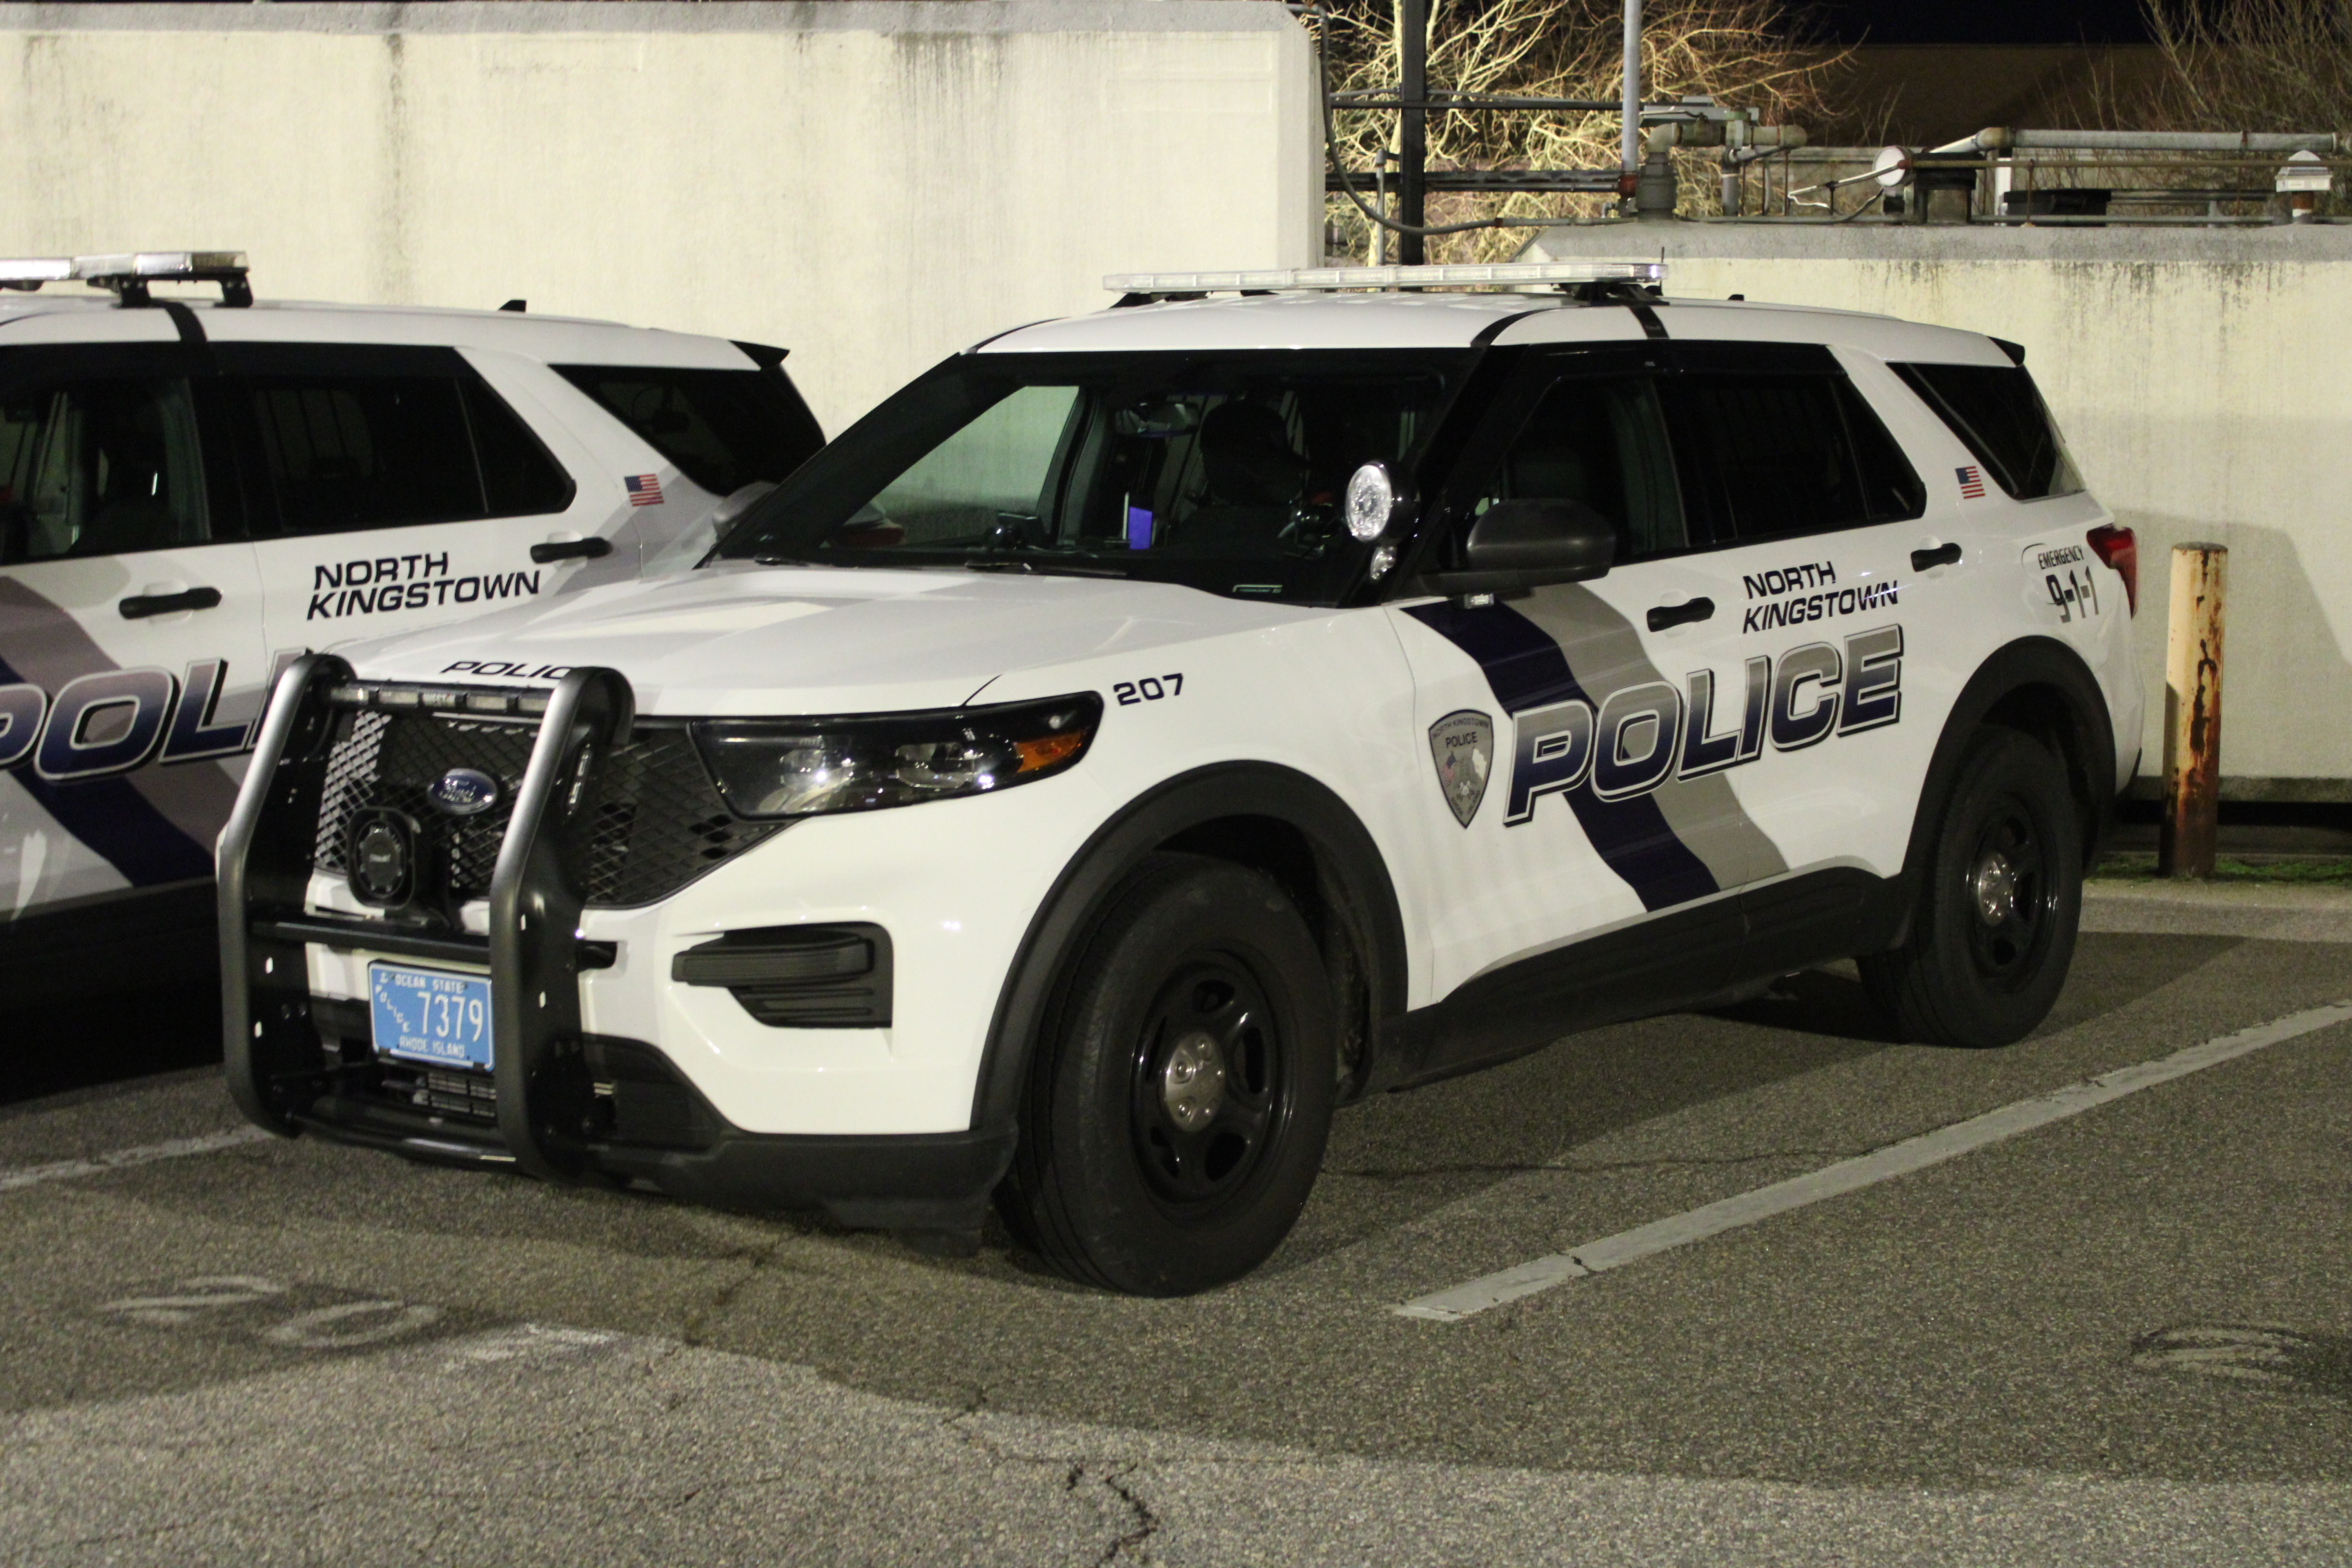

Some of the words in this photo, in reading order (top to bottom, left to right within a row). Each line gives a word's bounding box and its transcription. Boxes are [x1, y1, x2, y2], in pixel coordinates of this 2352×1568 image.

[314, 551, 448, 590] NORTH
[2037, 544, 2085, 570] EMERGENCY
[307, 570, 540, 621] KINGSTOWN
[1743, 561, 1836, 599] NORTH
[2046, 566, 2099, 624] 9-1-1
[1743, 580, 1898, 634] KINGSTOWN
[439, 661, 573, 679] POLIC
[1113, 673, 1184, 706] 207
[1446, 731, 1477, 748] POLICE
[1503, 624, 1903, 829] POLICE
[394, 973, 426, 989] OCEAN
[432, 978, 465, 994] STATE
[375, 984, 411, 1033] POLICE
[417, 991, 483, 1043] 7379
[399, 1035, 429, 1053] RHODE
[432, 1040, 465, 1059] ISLAND
